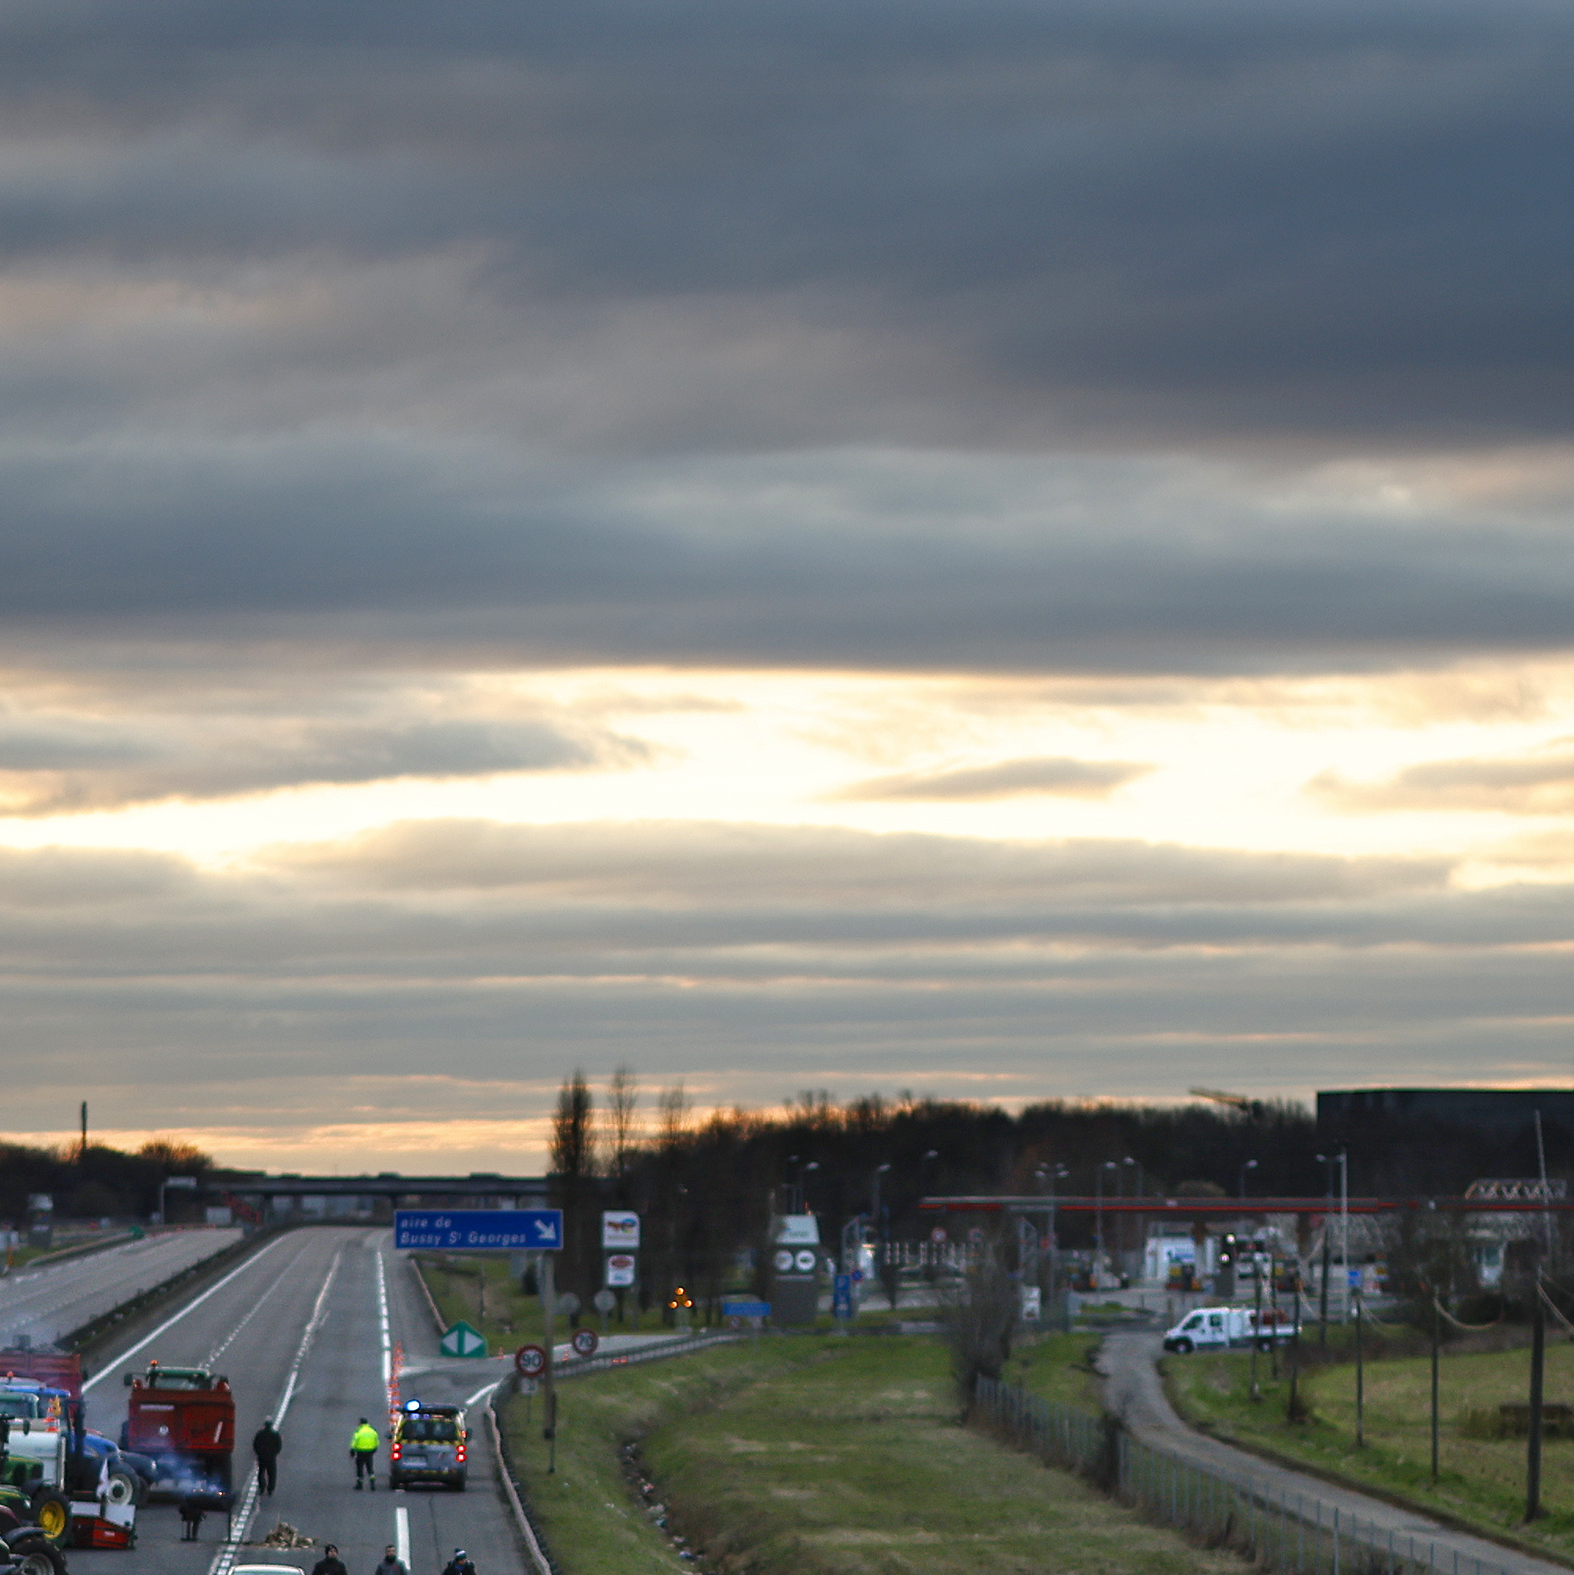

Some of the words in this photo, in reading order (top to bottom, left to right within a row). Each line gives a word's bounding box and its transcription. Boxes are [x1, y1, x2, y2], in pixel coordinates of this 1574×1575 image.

[400, 1218, 428, 1228] aire
[435, 1216, 452, 1228] de
[400, 1231, 441, 1246] Bussy
[468, 1231, 526, 1246] Georges
[521, 1353, 541, 1368] 90
